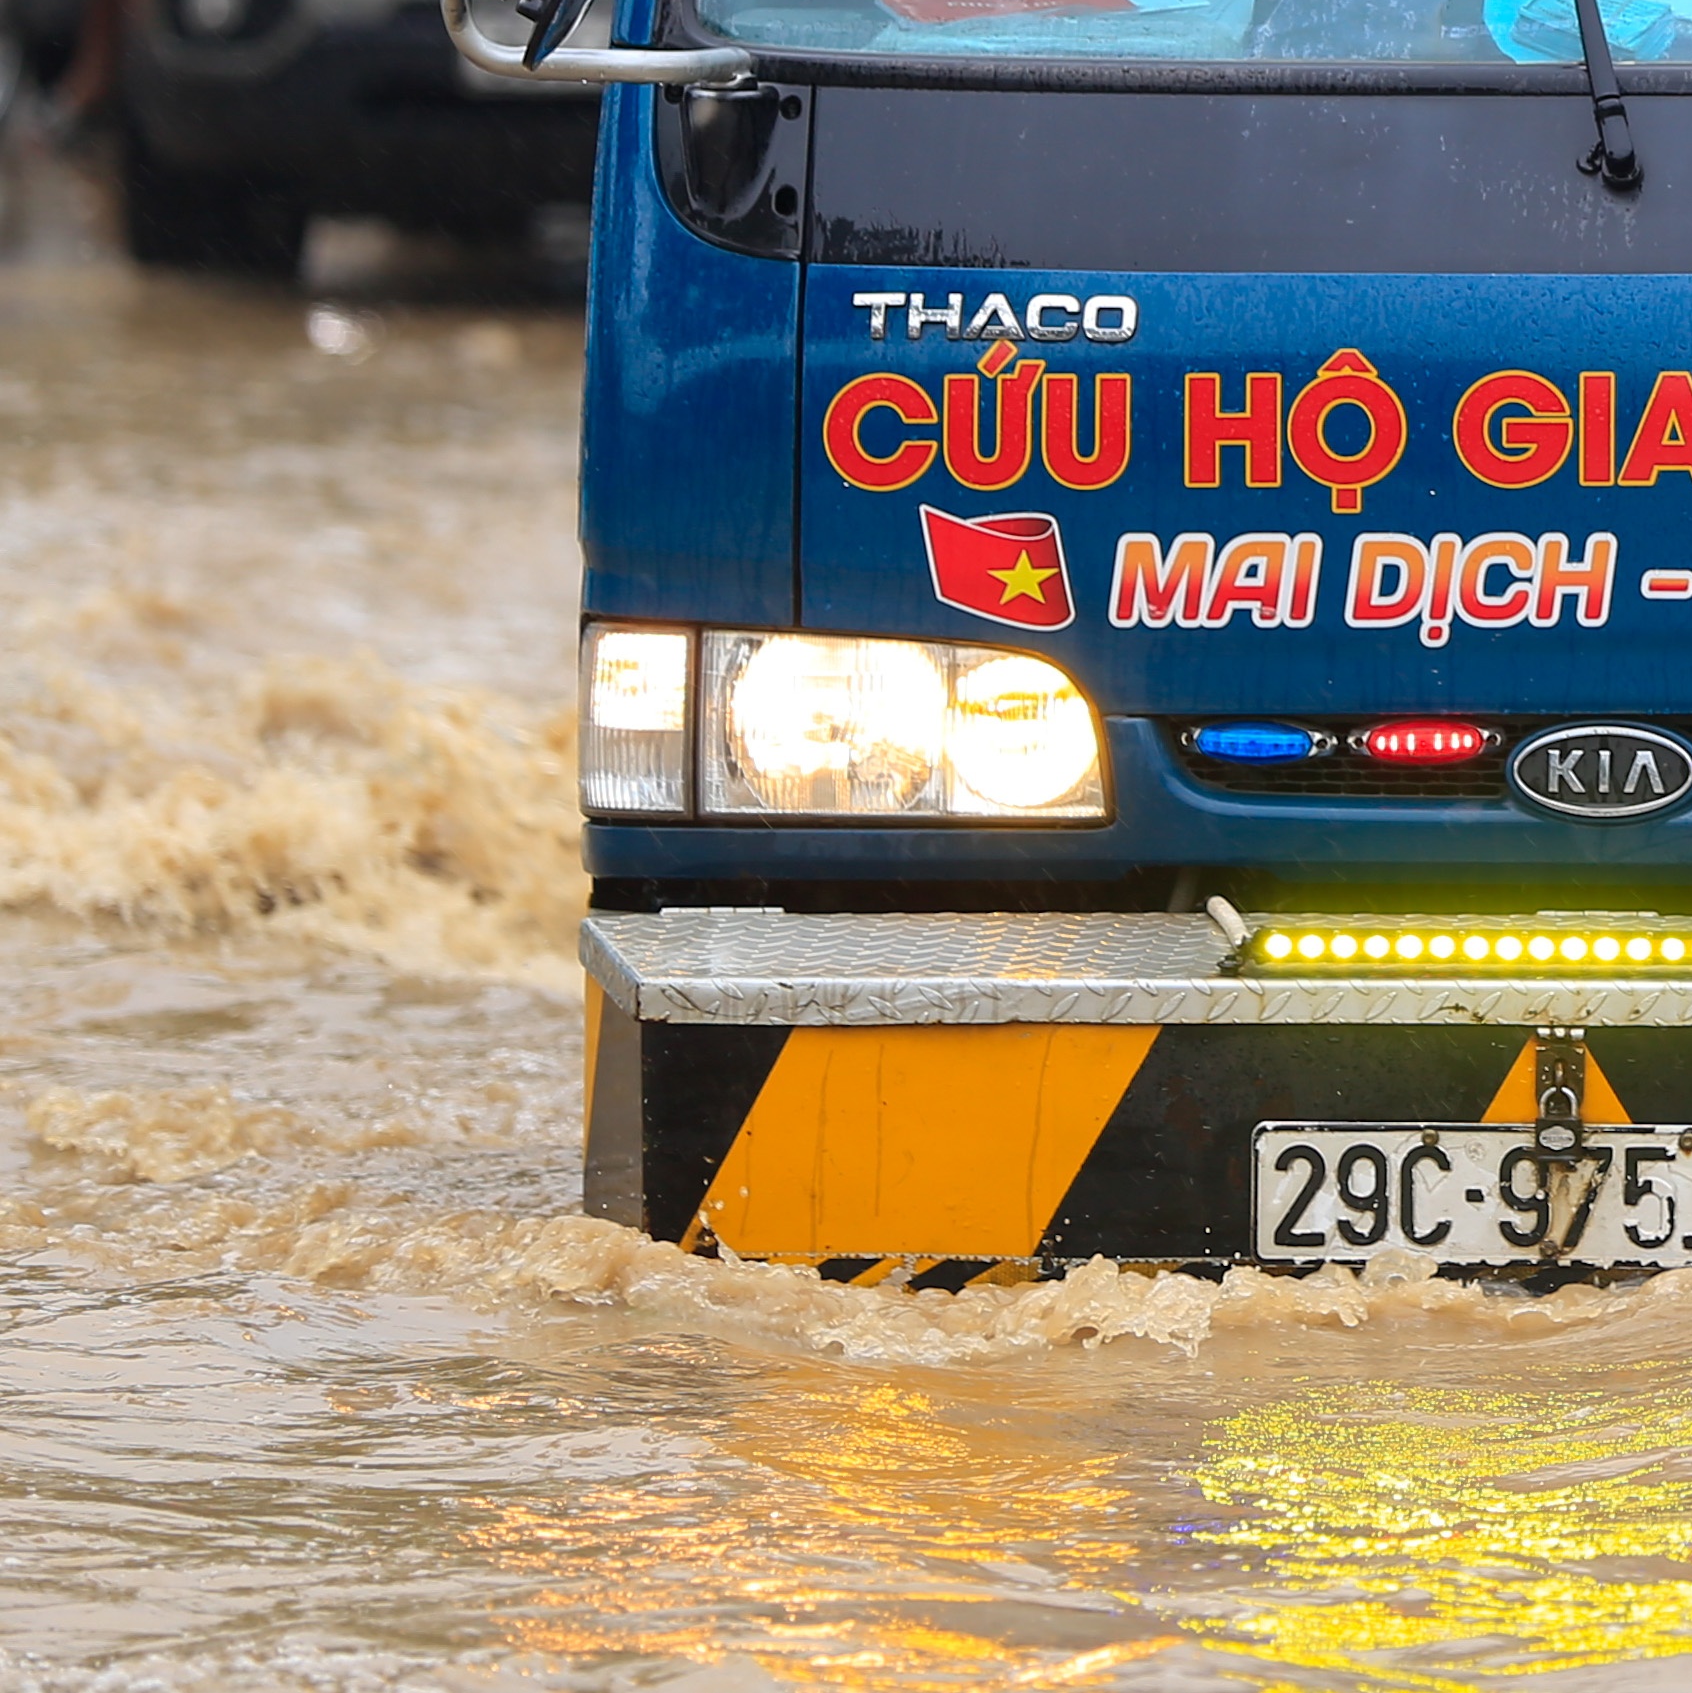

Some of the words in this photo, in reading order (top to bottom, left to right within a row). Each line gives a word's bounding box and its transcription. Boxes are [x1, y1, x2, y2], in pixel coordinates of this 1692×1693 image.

[853, 292, 1138, 342] THACO
[823, 339, 1131, 491] CỨU
[1184, 348, 1407, 513] HỘ
[1108, 532, 1322, 628] MAI
[1344, 532, 1617, 648] DỊCH
[1544, 748, 1668, 796] KIA
